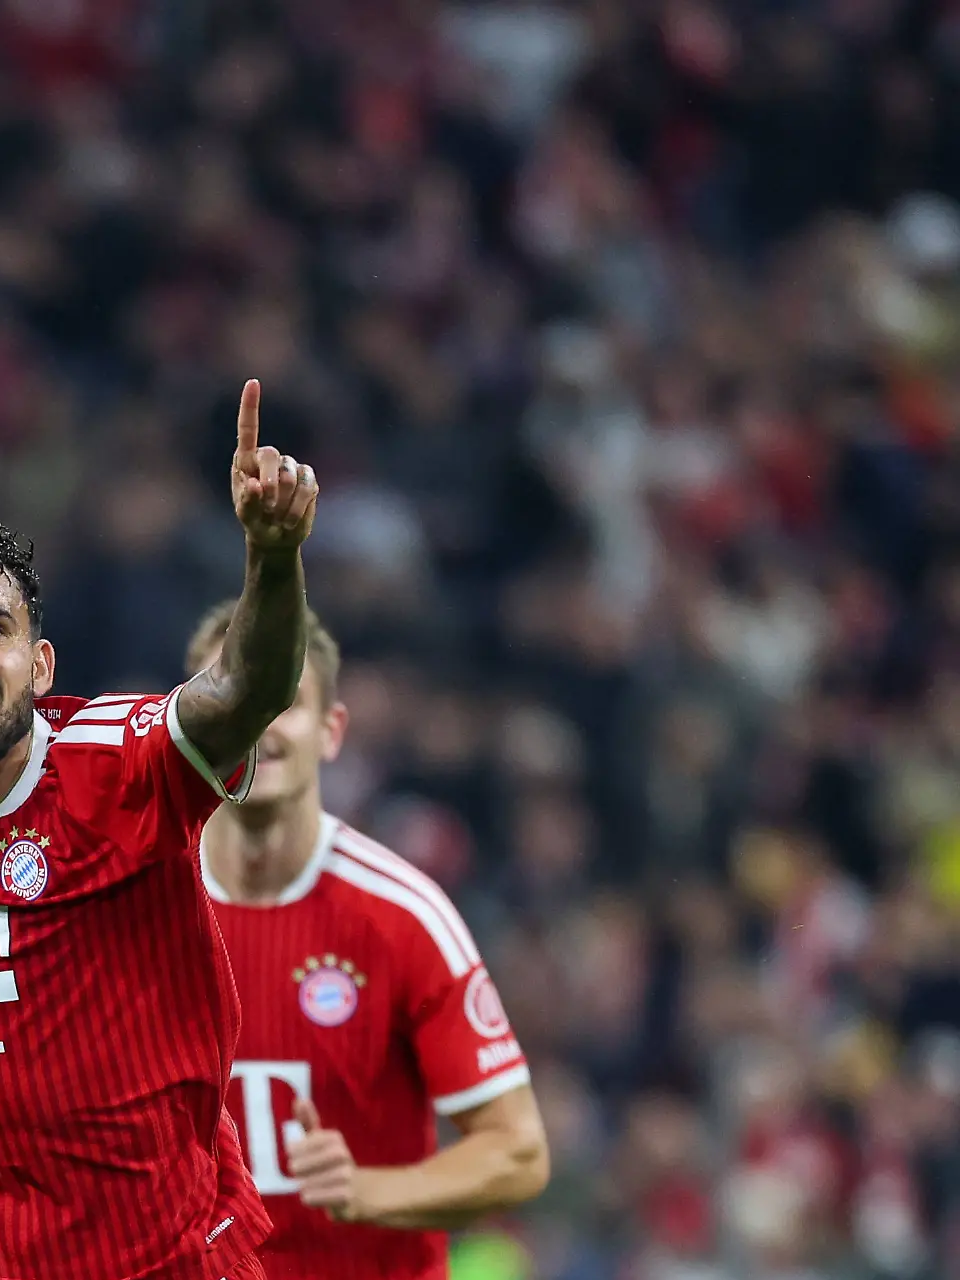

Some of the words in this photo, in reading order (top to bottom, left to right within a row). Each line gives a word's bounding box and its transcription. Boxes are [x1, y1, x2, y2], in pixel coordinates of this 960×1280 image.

[5, 859, 12, 876] FC
[9, 844, 40, 861] BAYERN
[230, 1060, 311, 1195] T
